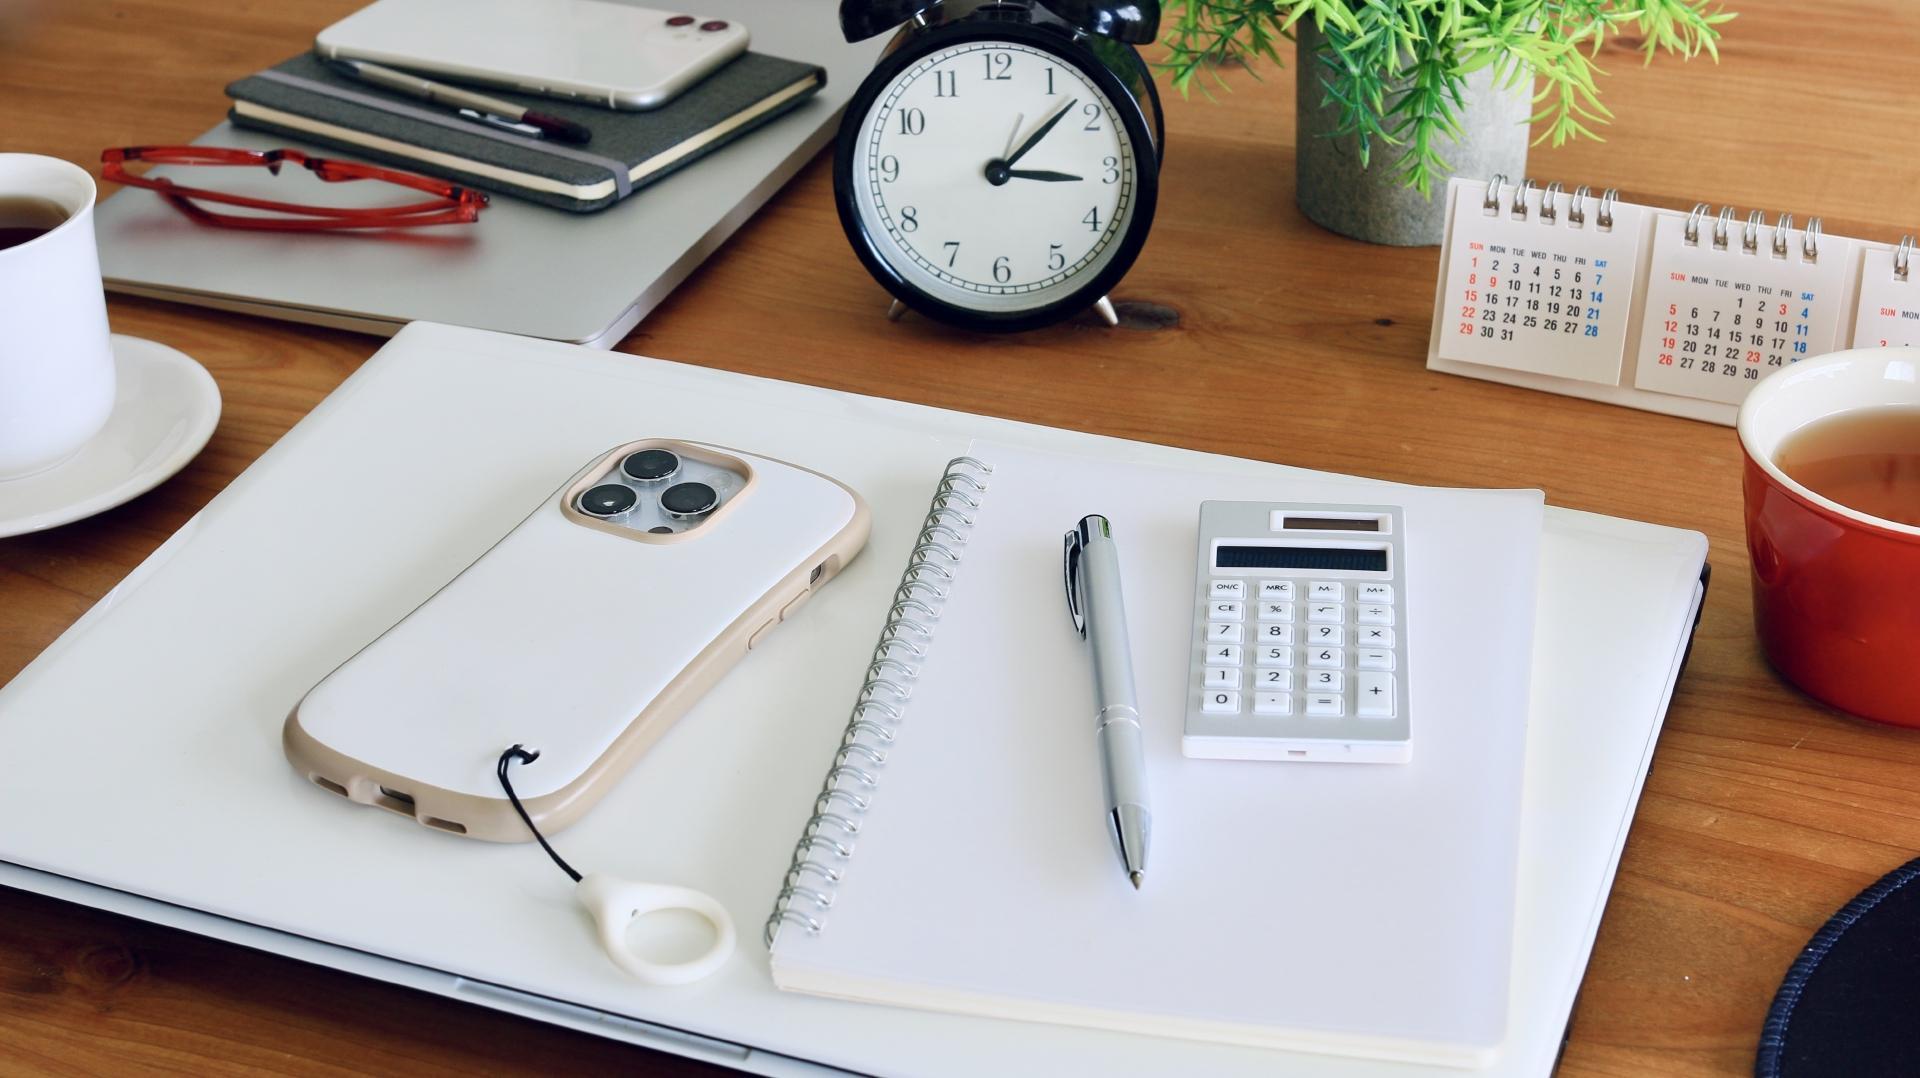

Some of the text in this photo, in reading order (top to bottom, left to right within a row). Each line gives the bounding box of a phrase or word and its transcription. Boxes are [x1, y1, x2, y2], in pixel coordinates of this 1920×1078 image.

[983, 52, 1013, 81] 12
[934, 70, 960, 98] 11
[1045, 67, 1057, 95] 1
[898, 107, 925, 136] 10
[1083, 103, 1102, 132] 2
[880, 155, 900, 183] 9
[1102, 156, 1119, 185] 3
[900, 205, 918, 232] 8
[1082, 205, 1102, 232] 4
[943, 241, 961, 268] 7
[1047, 244, 1066, 271] 5
[1490, 245, 1505, 253] MON
[1513, 248, 1524, 256] TUE
[1532, 251, 1546, 259] WED
[1554, 254, 1566, 262] THU
[1575, 257, 1586, 265] FRI
[992, 256, 1012, 284] 6
[1472, 257, 1602, 285] 1 2 3 4 5 6 7
[1469, 274, 1602, 303] 8 9 10 11 12 13 14
[1671, 272, 1685, 281] SUN
[1692, 276, 1708, 284] MON
[1735, 283, 1750, 291] WED
[1758, 286, 1772, 294] THU
[1801, 293, 1814, 301] SAT
[1465, 290, 1599, 319] 15 16 17 18 19 20 21
[1738, 298, 1808, 318] 1 2 3 4
[1881, 308, 1919, 319] SUN MON
[1460, 323, 1513, 341] 29 30 31
[1462, 306, 1598, 337] 22 23 24 25 26 27 28
[1670, 304, 1808, 336] 5 6 7 8 9 10 11
[1665, 321, 1806, 353] 12 13 14 15 16 17 18
[1663, 337, 1675, 349] 19
[1683, 341, 1696, 352] 20
[1704, 344, 1717, 356] 21
[1726, 347, 1739, 359] 22
[1747, 351, 1760, 363] 23
[1768, 355, 1782, 366] 24
[1659, 354, 1758, 379] 26 27 28 29 30
[1318, 585, 1334, 593] M-
[1221, 625, 1230, 634] 7
[1270, 626, 1281, 635] 8
[1321, 628, 1330, 636] 9
[1219, 648, 1229, 657] 4
[1270, 649, 1280, 658] 5
[1320, 651, 1330, 659] 6
[1221, 671, 1225, 679] 1
[1269, 672, 1279, 681] 2
[1320, 673, 1331, 682] 3
[1216, 694, 1227, 703] 0
